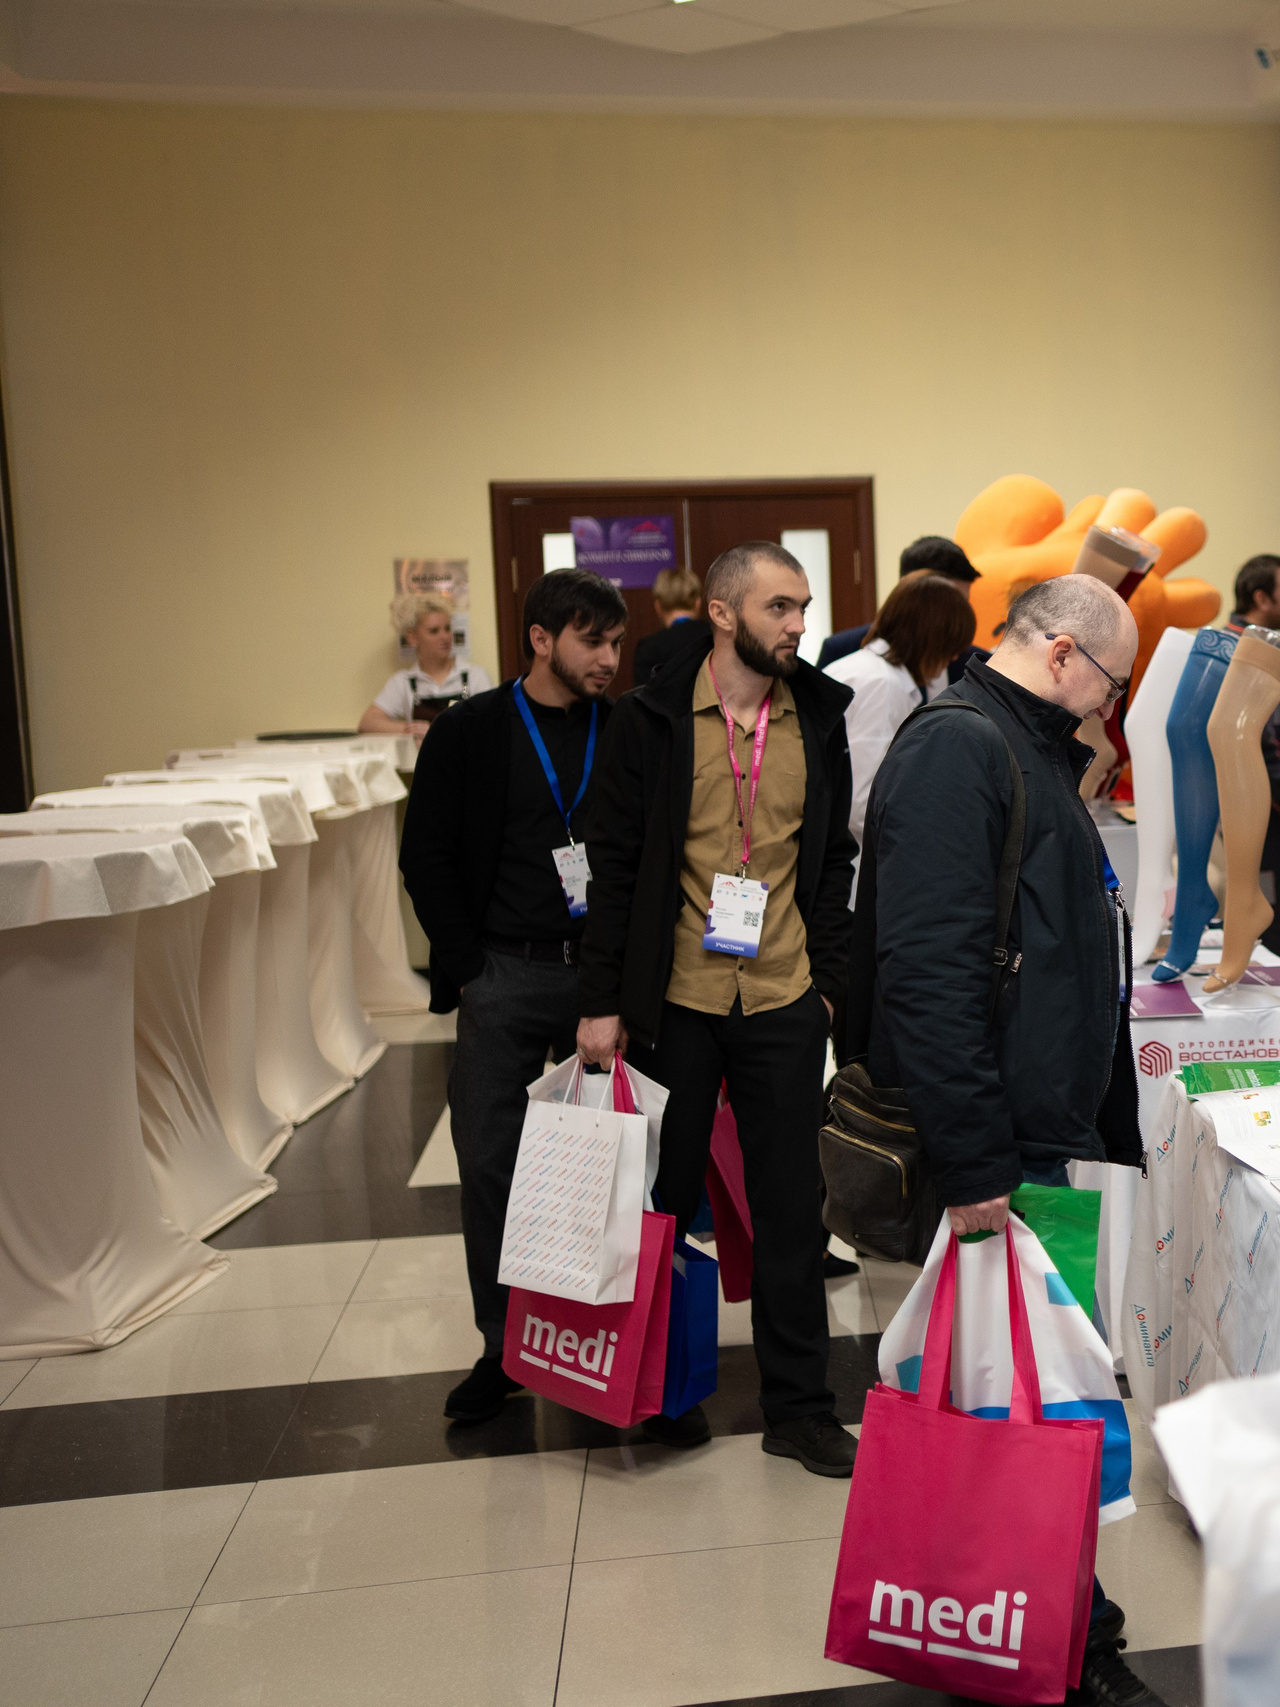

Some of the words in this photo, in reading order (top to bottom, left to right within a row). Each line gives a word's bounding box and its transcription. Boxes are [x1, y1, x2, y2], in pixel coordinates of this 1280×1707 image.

[715, 942, 745, 952] УЧАСТНИК
[522, 1313, 618, 1377] medi
[1134, 1304, 1155, 1367] Доминанта
[869, 1579, 1027, 1650] medi
